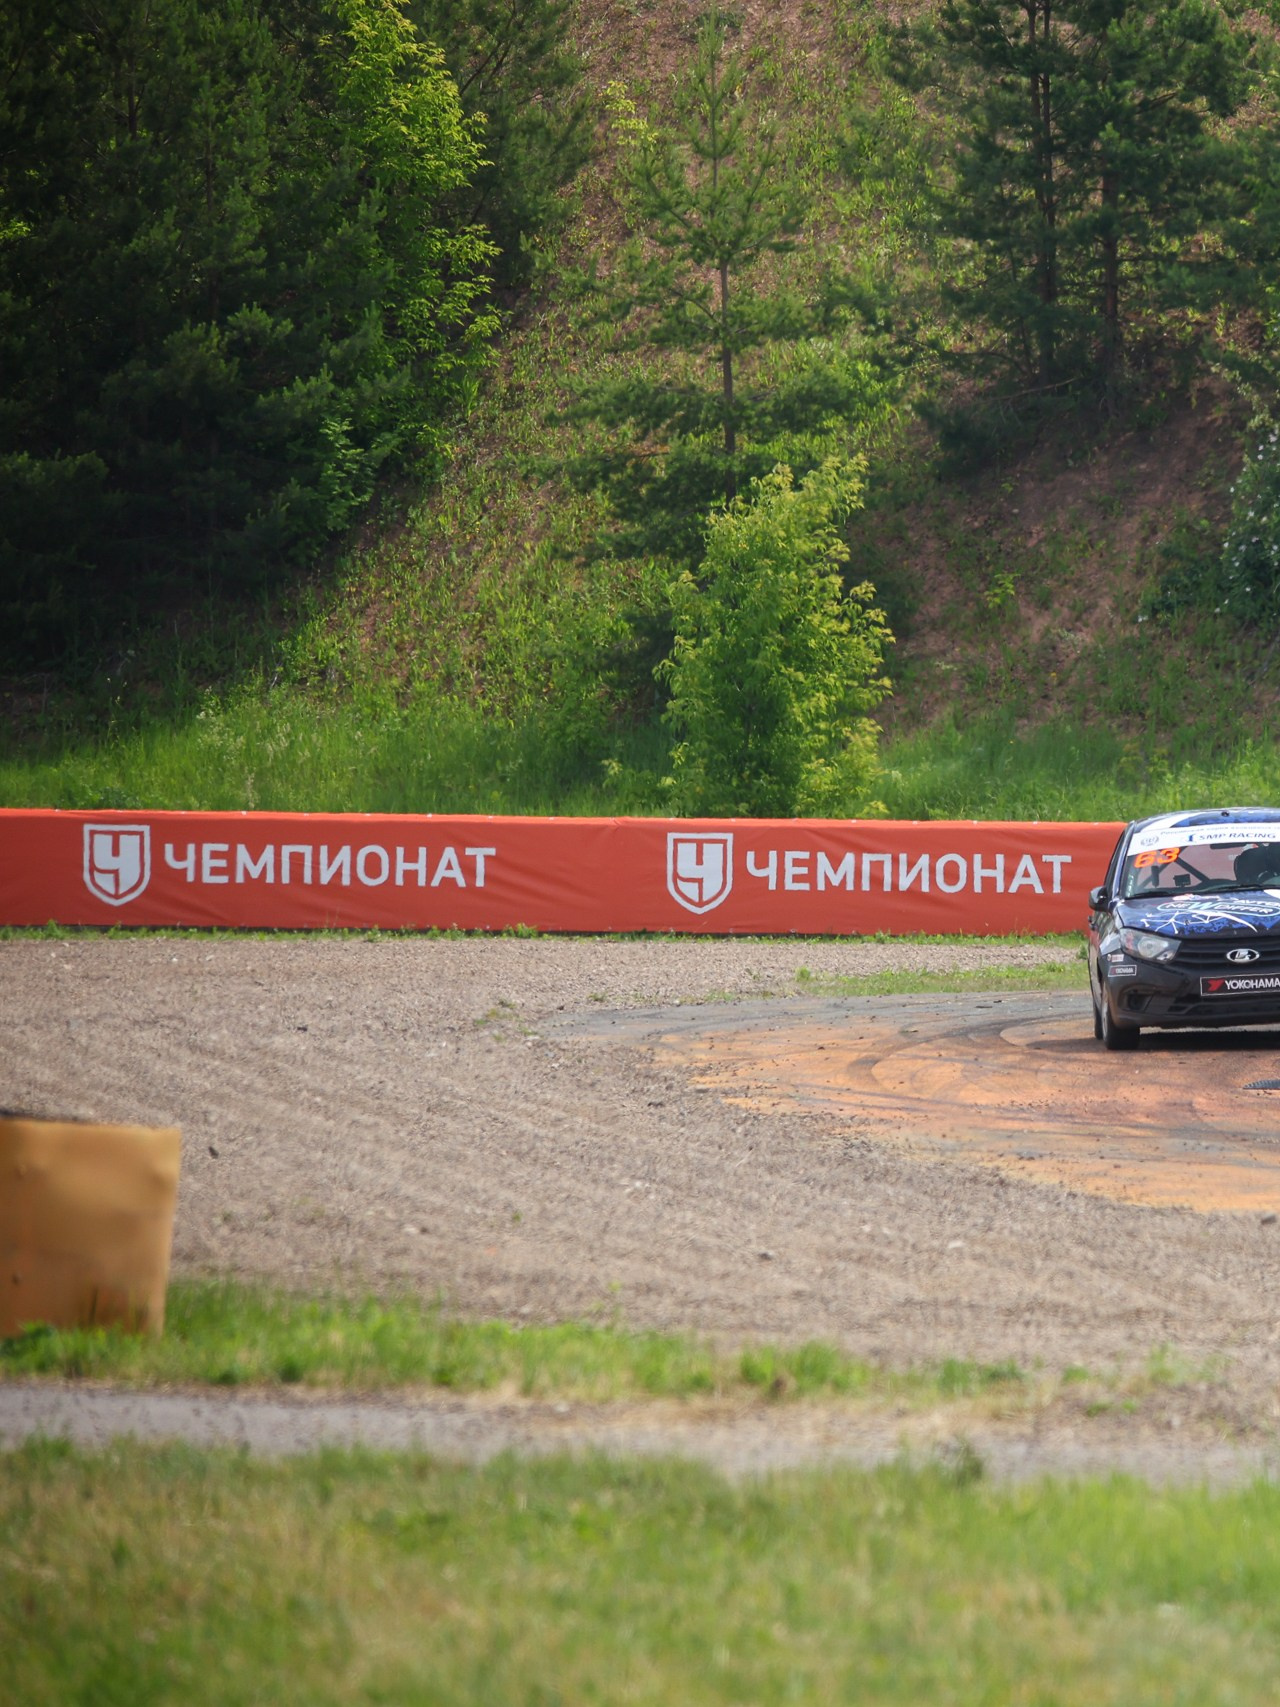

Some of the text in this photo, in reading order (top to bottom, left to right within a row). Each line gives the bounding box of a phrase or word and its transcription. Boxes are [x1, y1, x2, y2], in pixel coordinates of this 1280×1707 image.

[164, 842, 496, 888] ЧЕМПИОНАТ
[746, 850, 1072, 894] ЧЕМПИОНАТ
[1134, 847, 1180, 868] 63
[1225, 977, 1280, 990] YOKOHAMA
